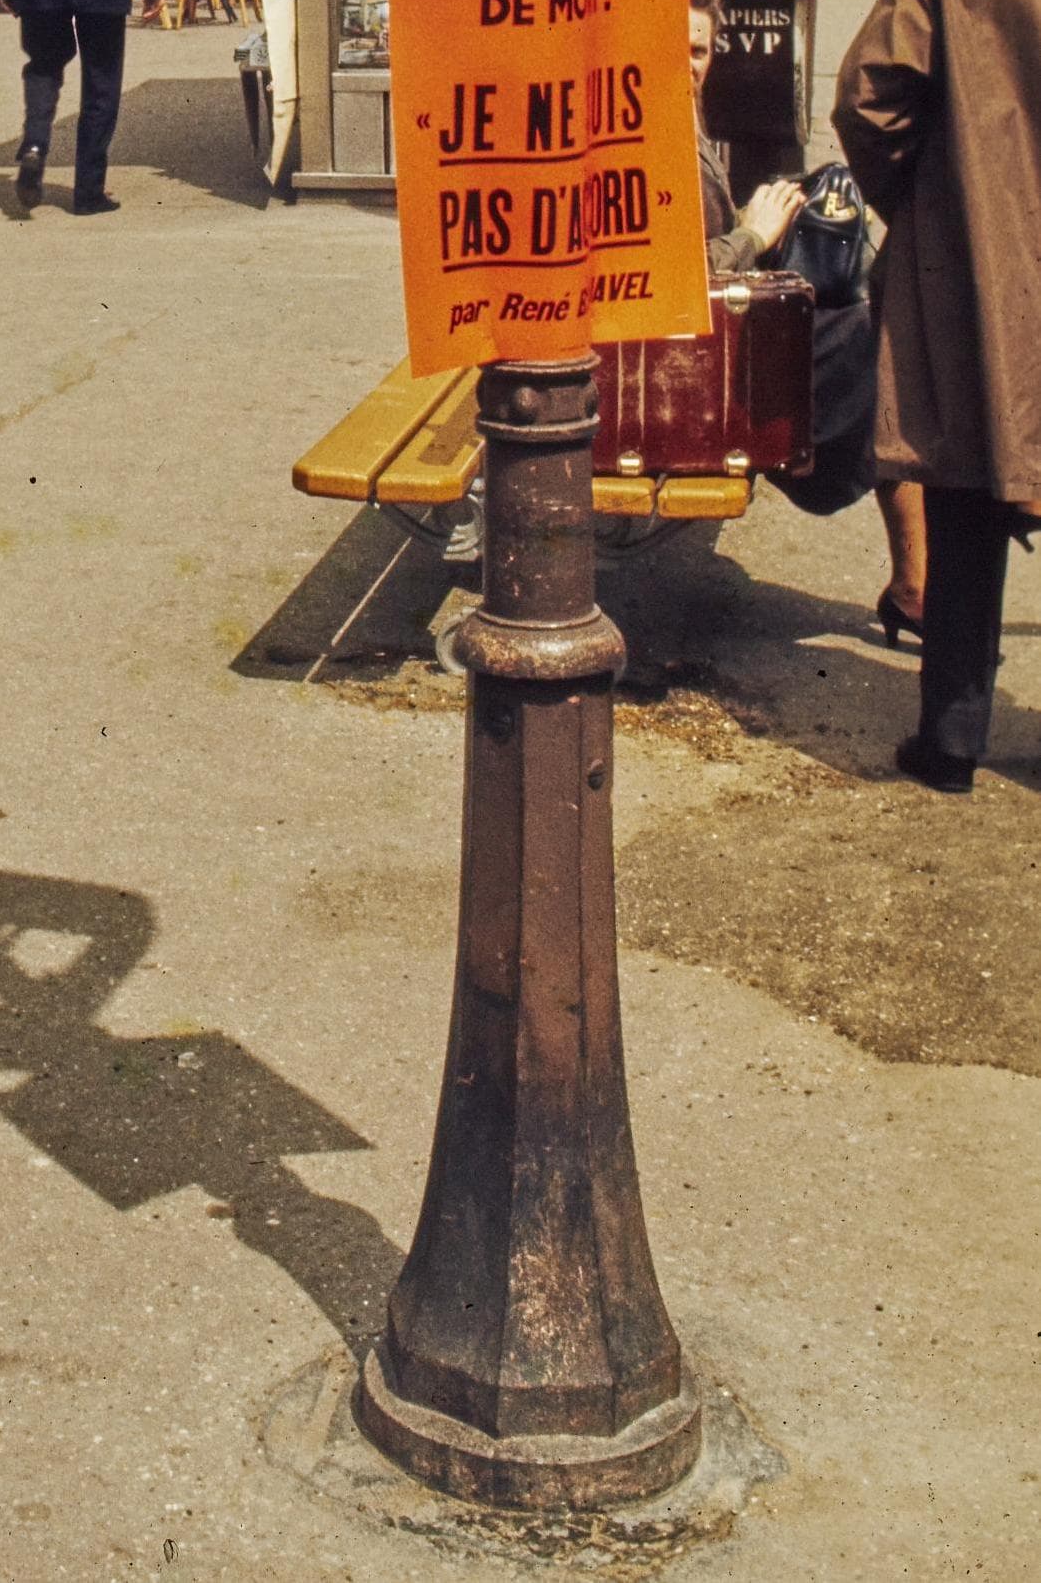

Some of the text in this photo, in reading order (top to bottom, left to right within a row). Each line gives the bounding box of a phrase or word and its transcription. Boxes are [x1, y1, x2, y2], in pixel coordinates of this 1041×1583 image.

[527, 80, 576, 152] NE
[440, 188, 513, 260] PAS
[449, 299, 490, 334] par
[500, 291, 571, 323] René
